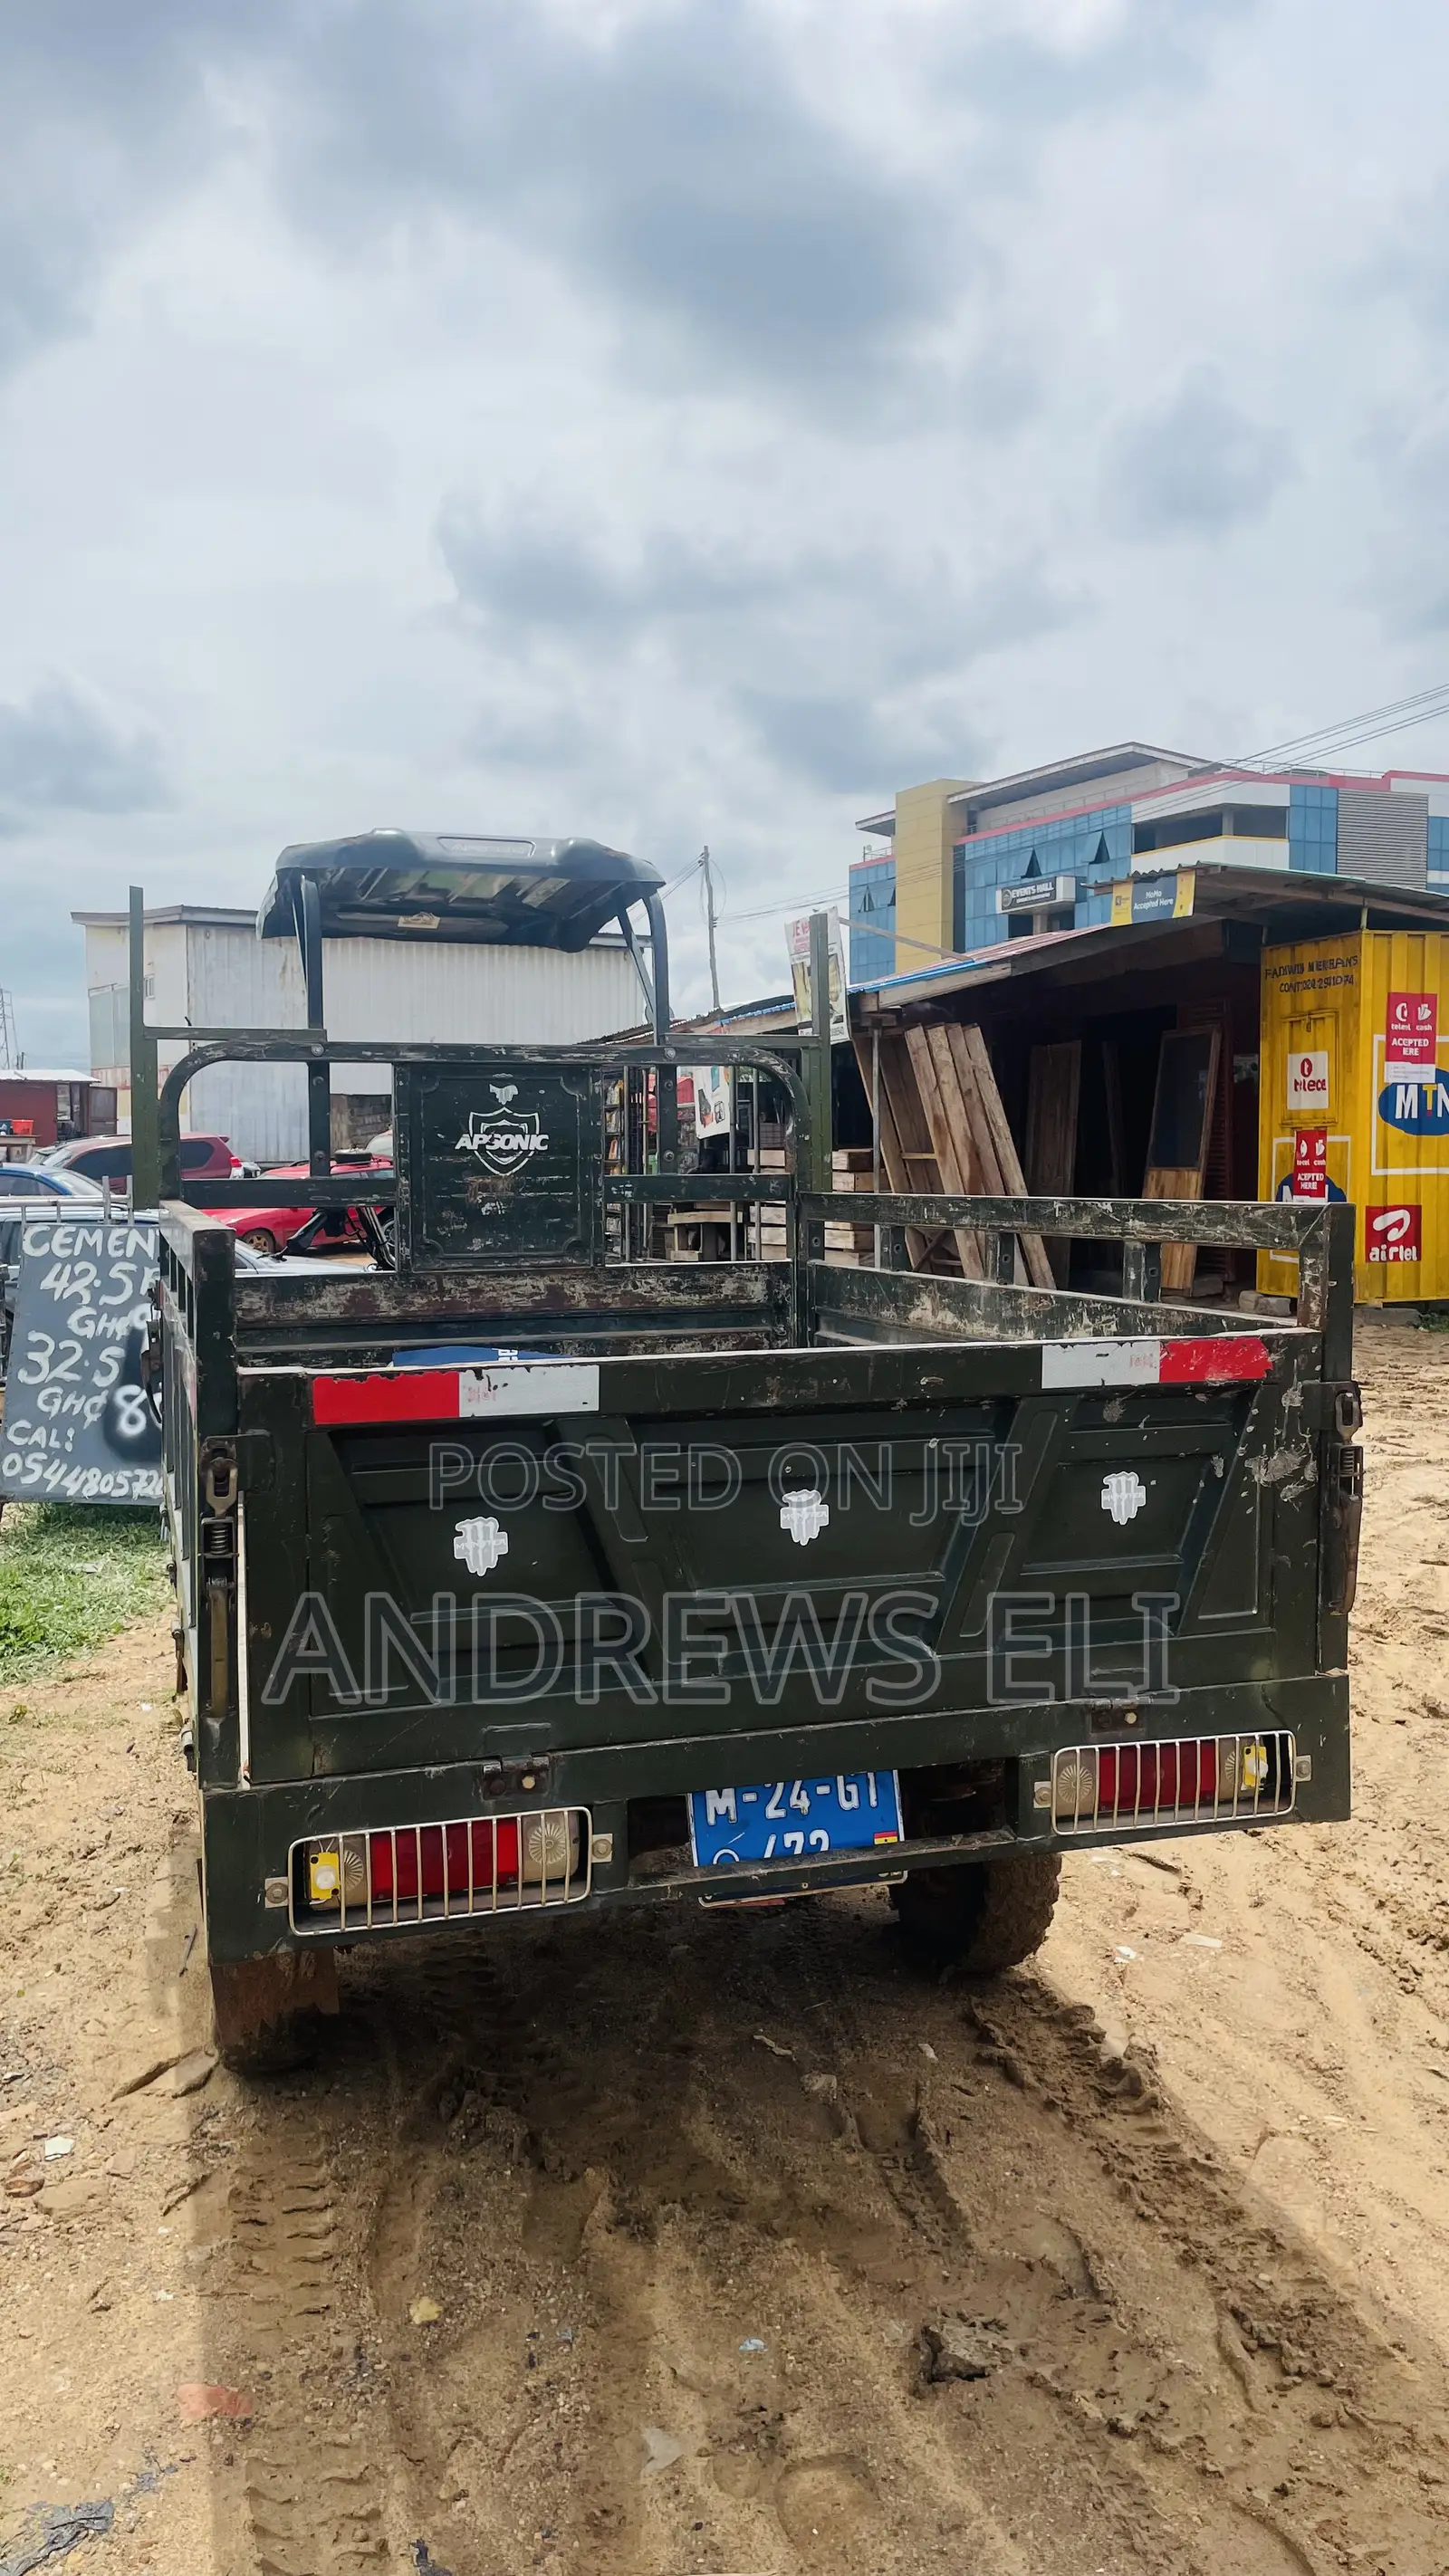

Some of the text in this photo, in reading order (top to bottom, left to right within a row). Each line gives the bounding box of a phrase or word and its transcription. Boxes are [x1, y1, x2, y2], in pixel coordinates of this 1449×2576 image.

[1012, 886, 1036, 898] EVENTS
[1037, 882, 1055, 894] HALL
[1146, 890, 1162, 899] MoMo
[1133, 899, 1159, 911] Accepted
[1159, 898, 1174, 906] Here
[455, 1134, 550, 1150] APSONIC
[23, 1225, 159, 1258] CEMEN
